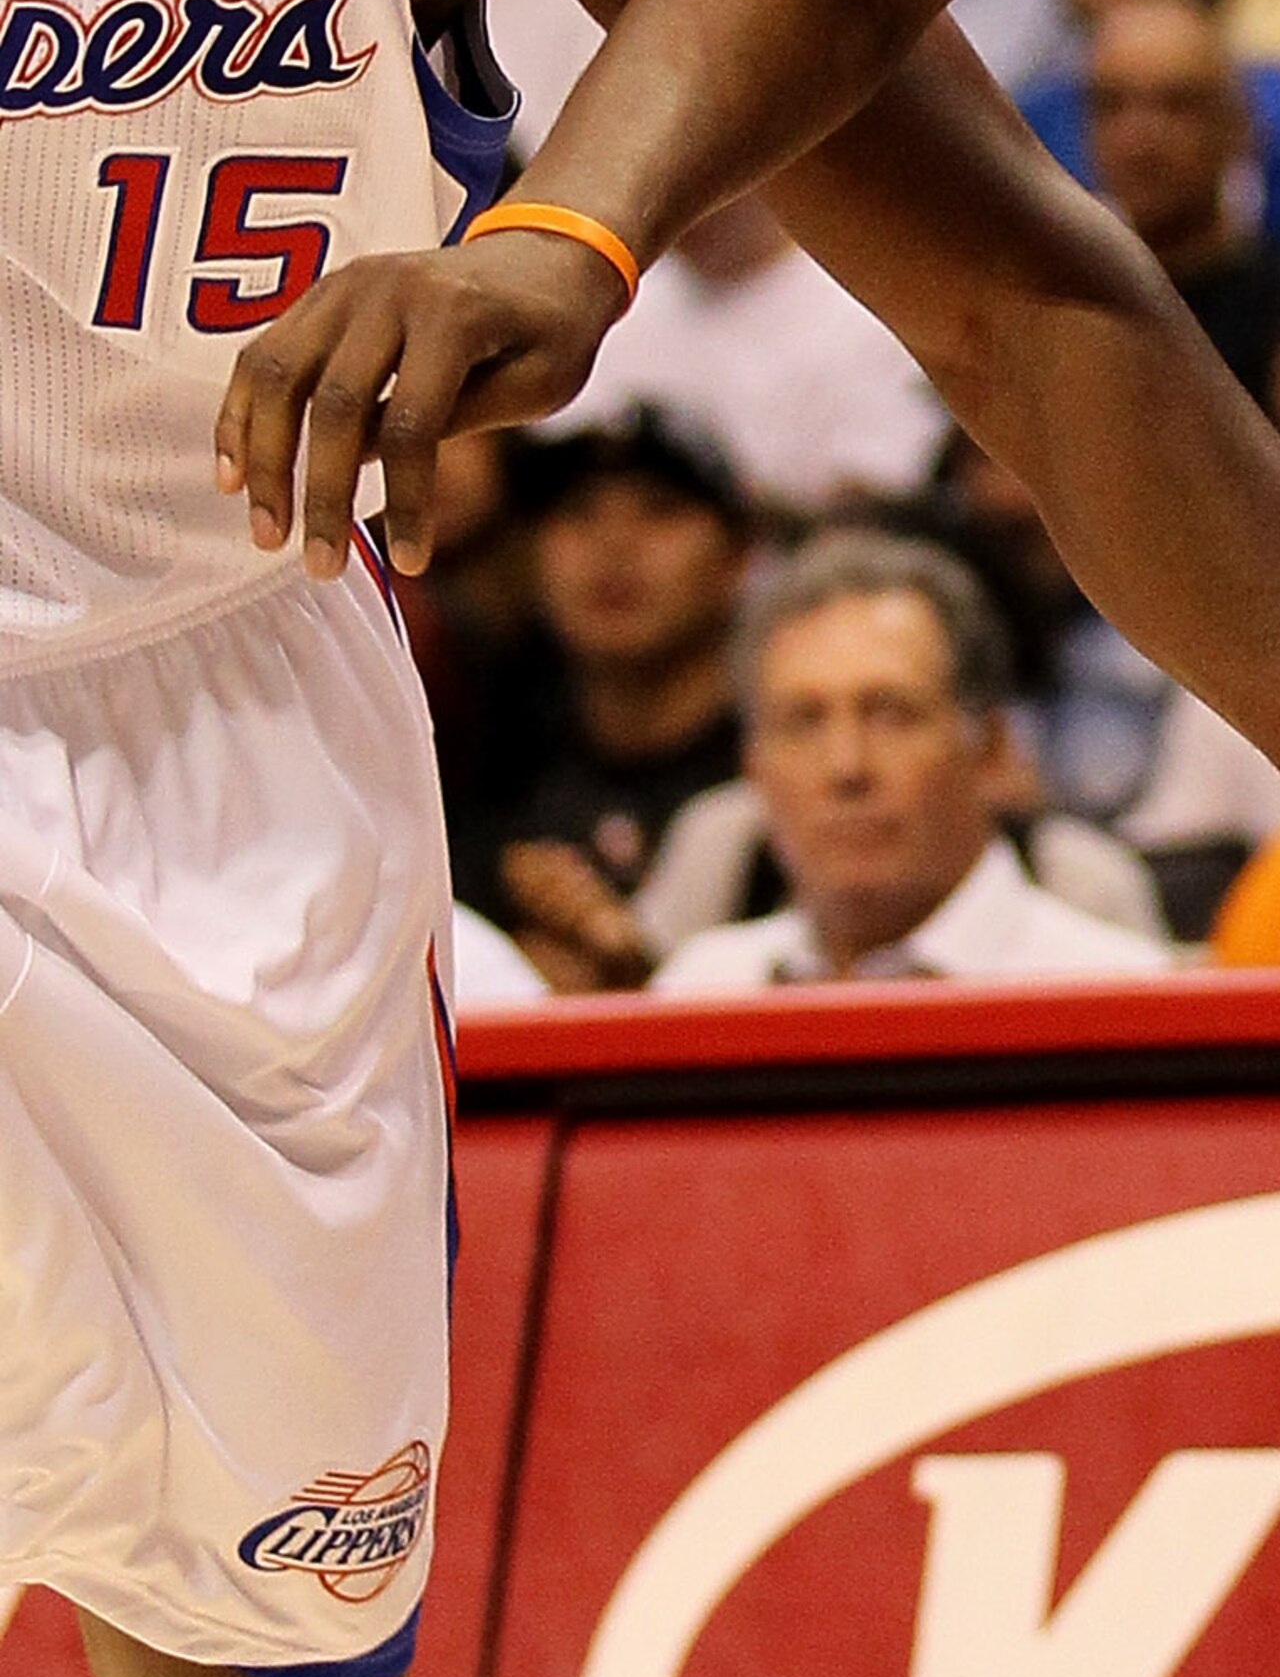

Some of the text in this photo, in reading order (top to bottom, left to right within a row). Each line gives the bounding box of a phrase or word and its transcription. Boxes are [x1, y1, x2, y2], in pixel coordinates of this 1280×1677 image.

[91, 152, 350, 335] 15
[238, 1505, 419, 1572] CLIPPERS
[341, 1508, 376, 1525] LOS
